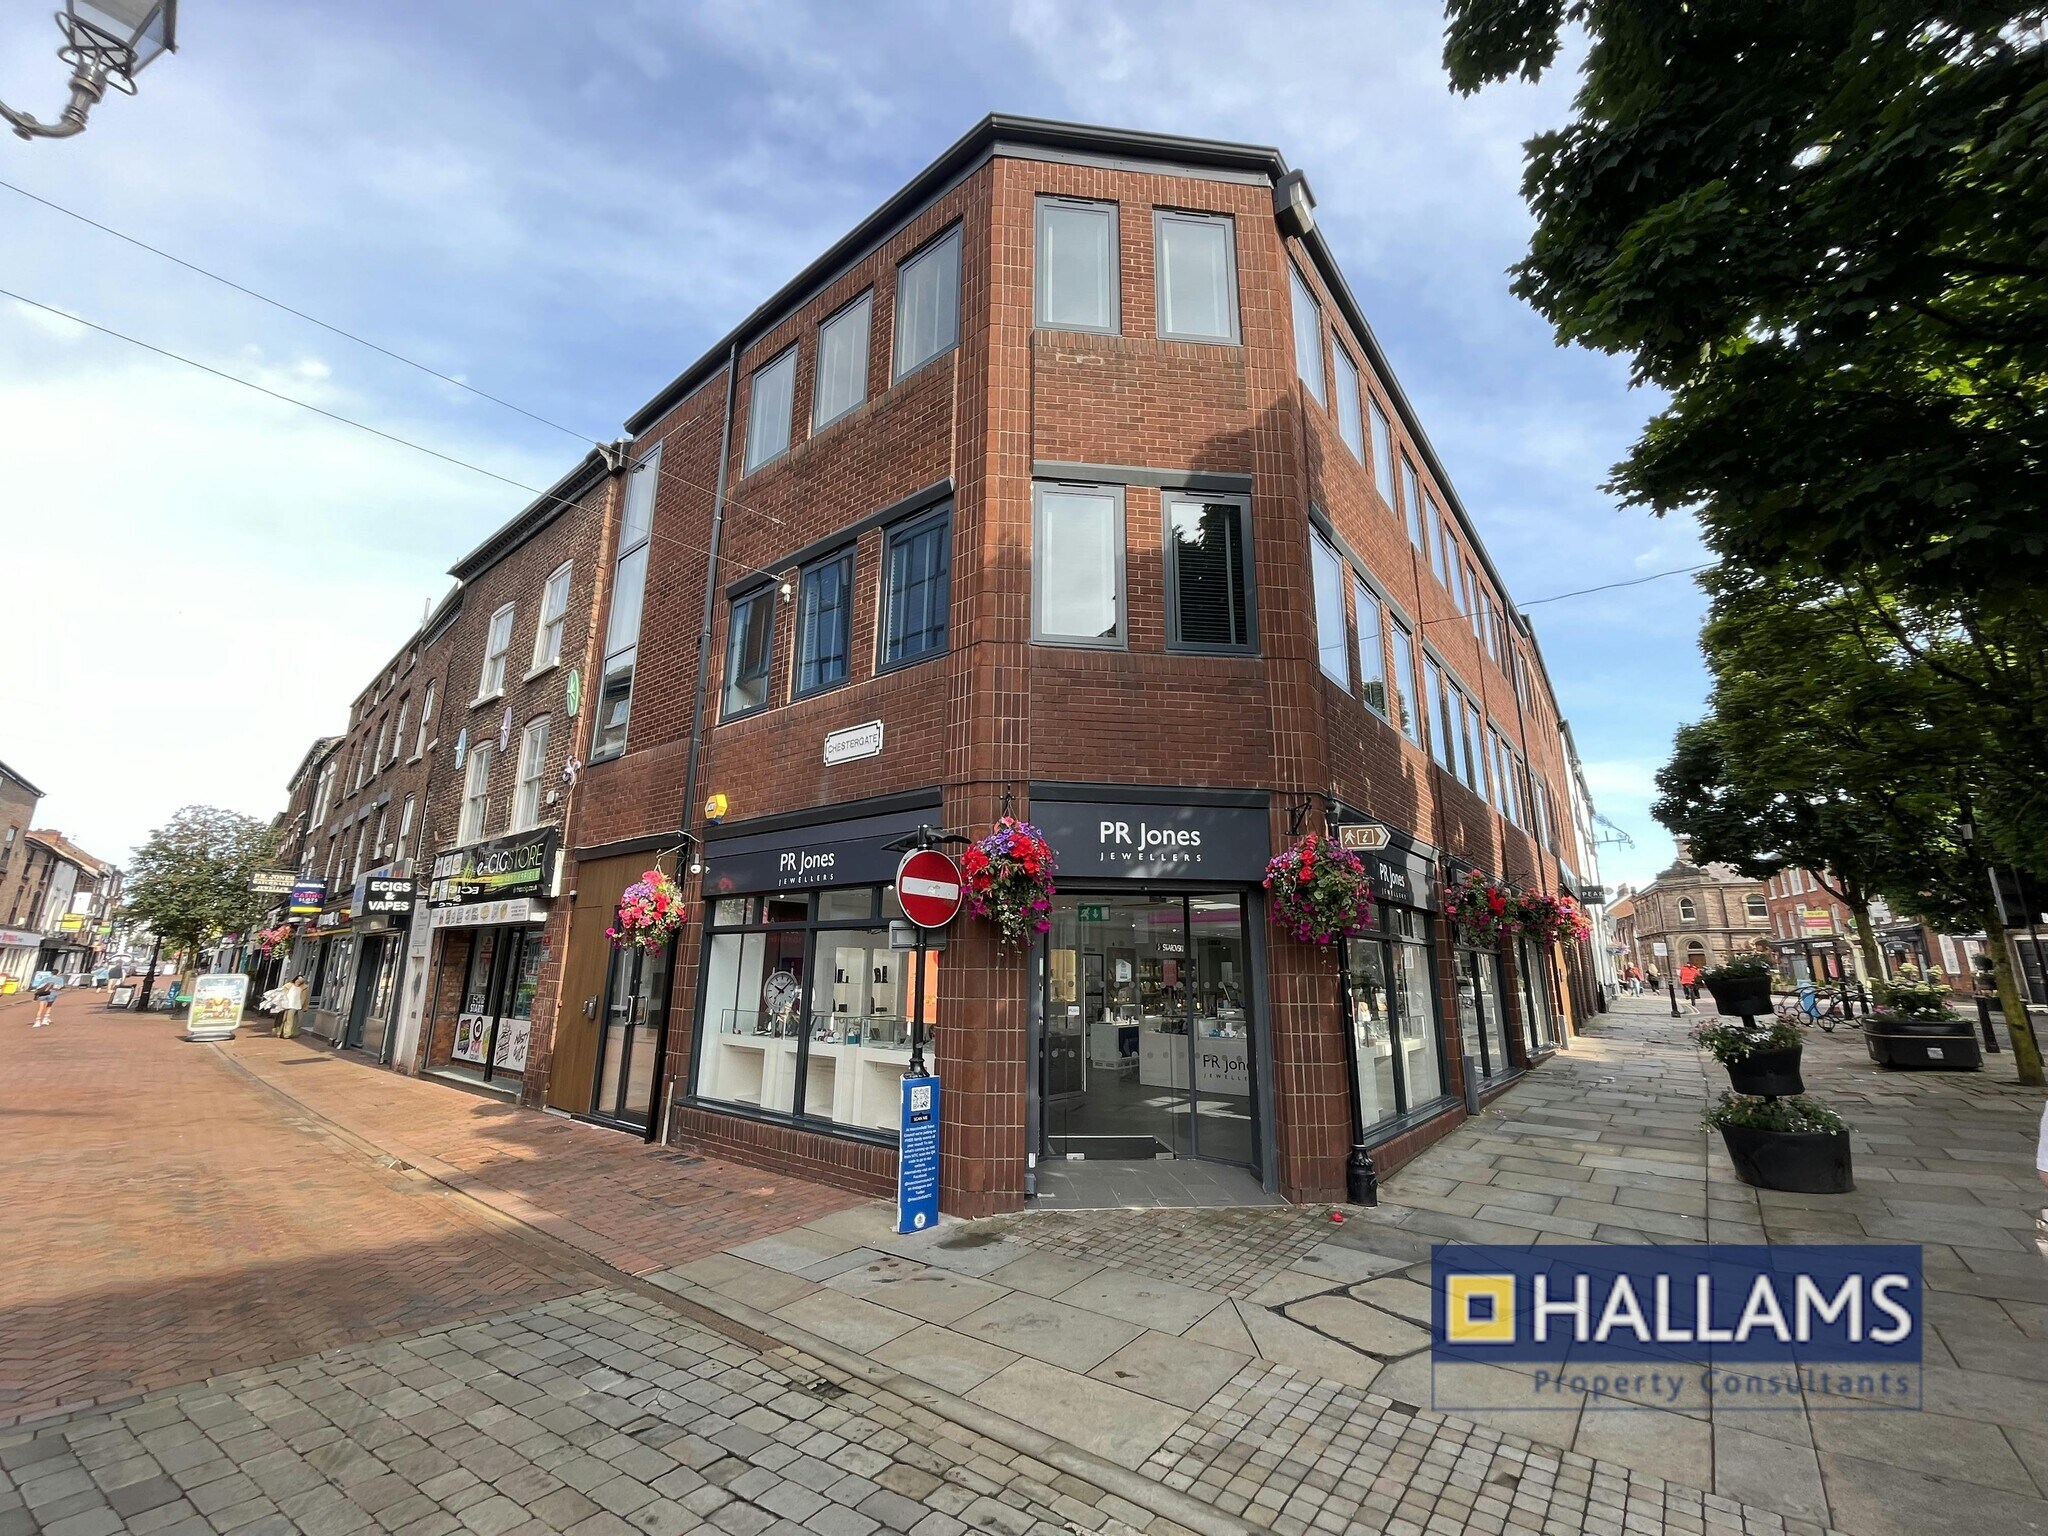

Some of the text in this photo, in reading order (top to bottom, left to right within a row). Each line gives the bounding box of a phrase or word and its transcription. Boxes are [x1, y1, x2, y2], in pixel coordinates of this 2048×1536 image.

[827, 733, 878, 753] CHESTERGATE
[1100, 821, 1201, 851] PR Jones
[780, 851, 835, 876] PR Jones
[1100, 852, 1202, 862] JEWELLERS
[778, 873, 834, 887] JEWELLERS
[1379, 862, 1405, 889] PR Jones
[370, 881, 412, 892] ECIGS
[384, 892, 396, 901] &
[1582, 890, 1605, 898] PEAK
[368, 901, 410, 911] VAPES
[1203, 1054, 1220, 1068] PR
